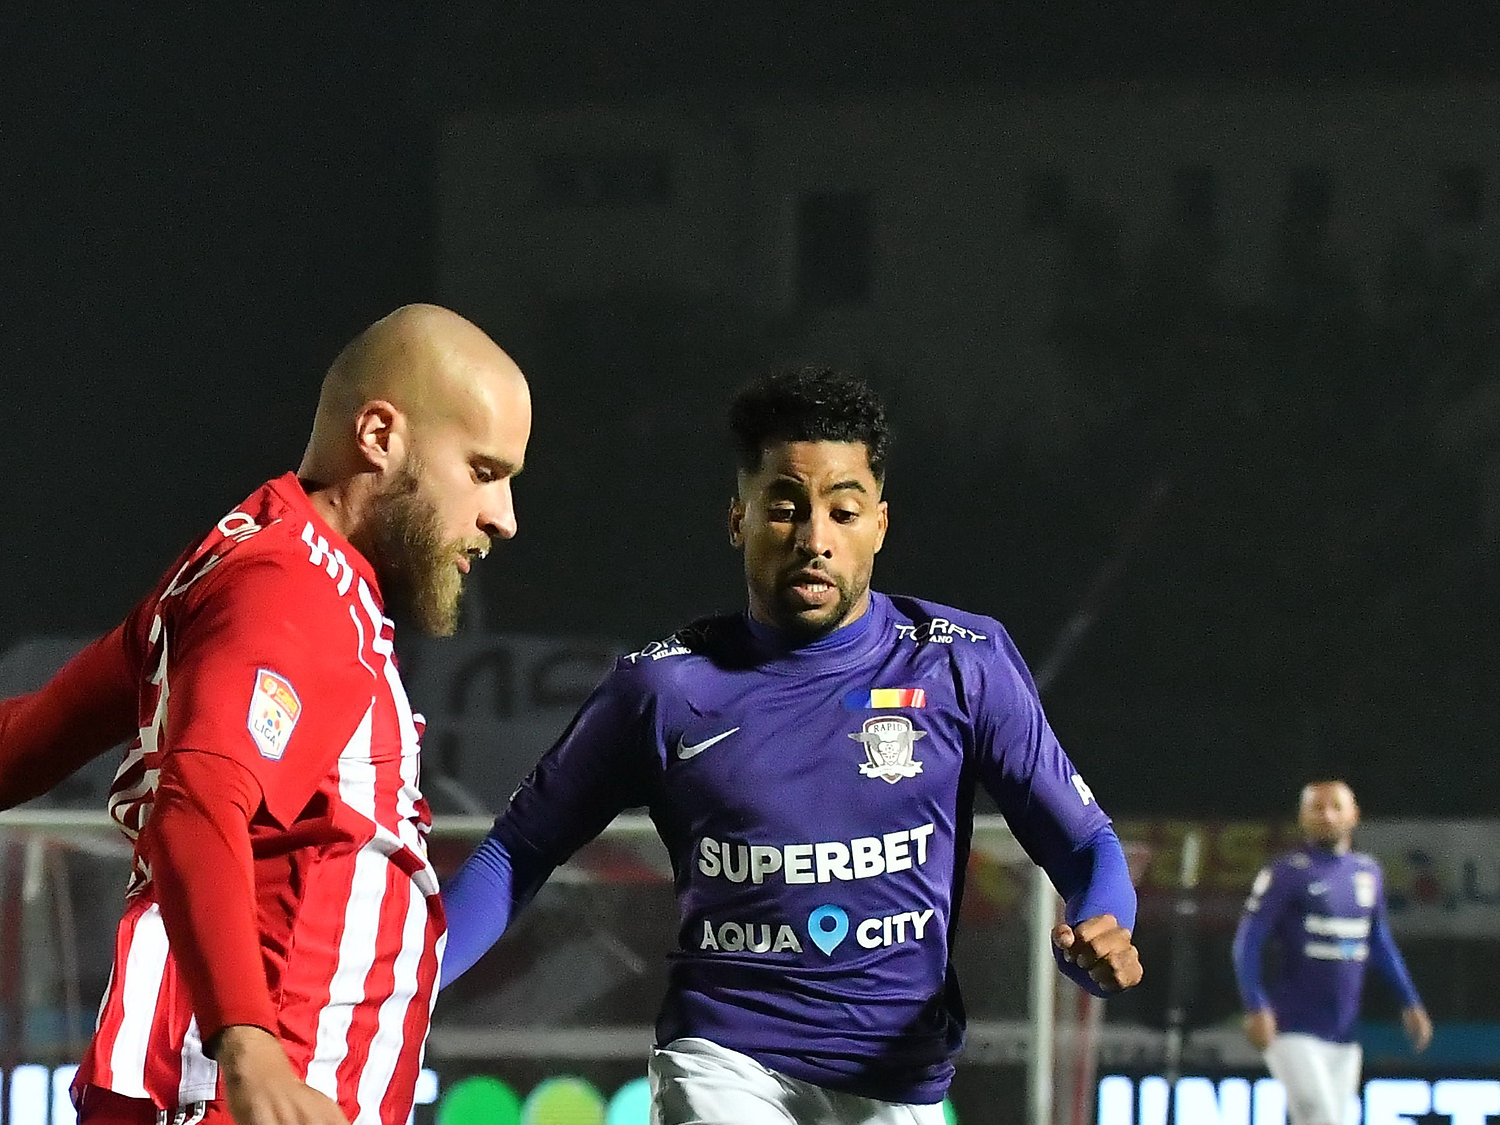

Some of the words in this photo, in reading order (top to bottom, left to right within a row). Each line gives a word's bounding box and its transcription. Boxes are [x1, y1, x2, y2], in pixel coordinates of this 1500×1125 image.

[894, 618, 987, 643] TORRY
[652, 646, 692, 661] MILANO
[253, 719, 276, 747] LIGA
[873, 723, 903, 733] RAPID
[698, 823, 935, 884] SUPERBET
[699, 920, 804, 954] AQUA
[855, 909, 935, 950] CITY
